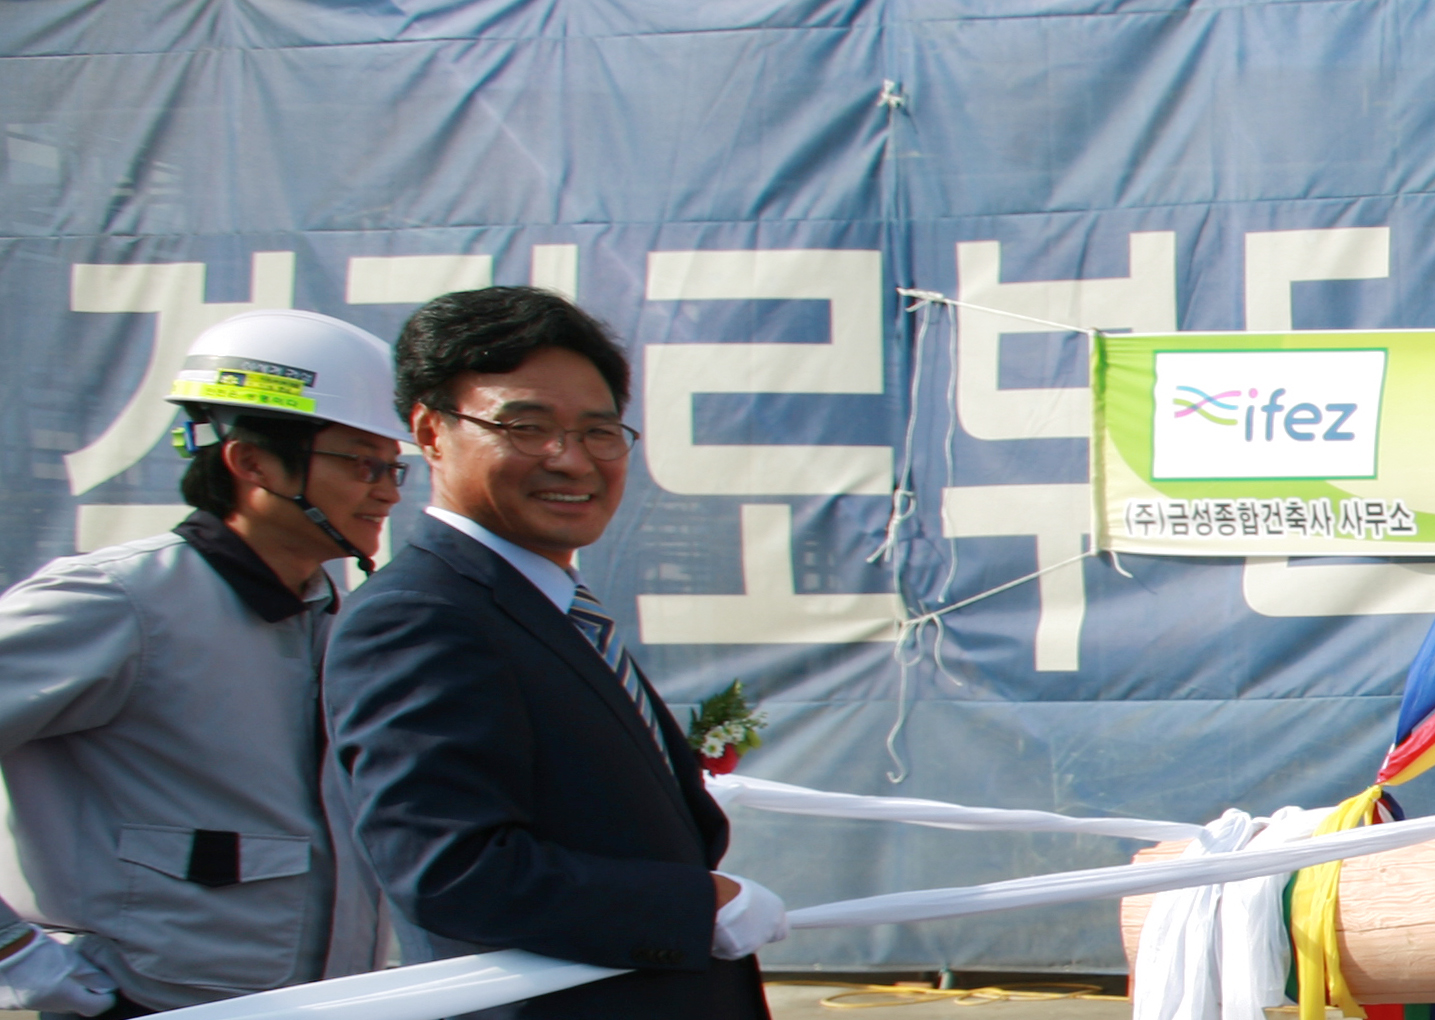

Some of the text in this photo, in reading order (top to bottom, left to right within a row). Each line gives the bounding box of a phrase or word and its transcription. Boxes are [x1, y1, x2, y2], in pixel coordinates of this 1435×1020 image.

[1243, 388, 1357, 443] ifez
[1124, 499, 1415, 540] (주)금성종합건축사 사무소
